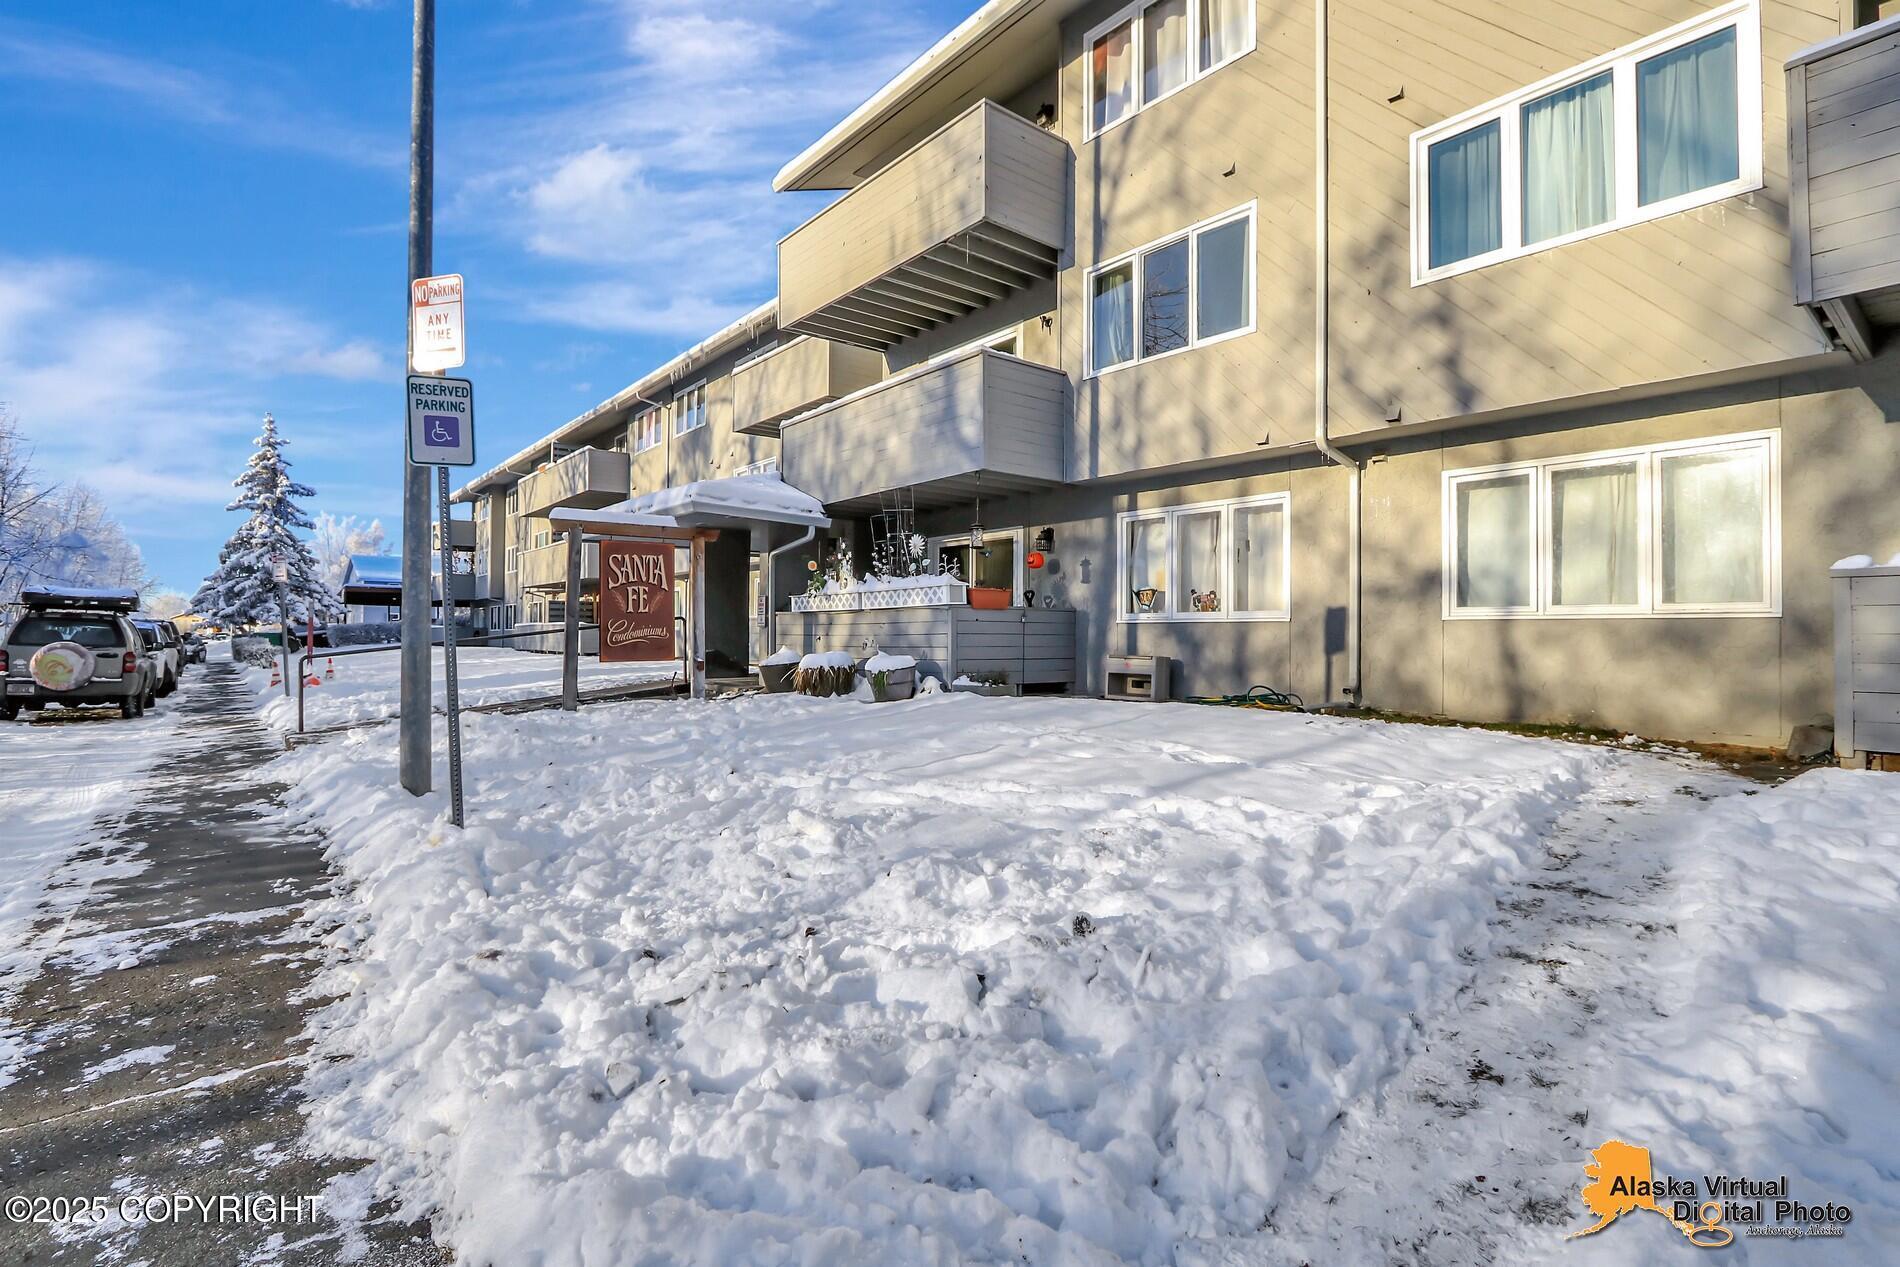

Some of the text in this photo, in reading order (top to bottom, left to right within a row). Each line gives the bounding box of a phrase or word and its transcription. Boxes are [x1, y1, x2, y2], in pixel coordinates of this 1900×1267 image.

[414, 283, 460, 303] NO PARKING
[428, 313, 449, 326] ANY
[427, 328, 452, 341] TIME
[410, 383, 469, 398] RESERVED
[415, 398, 466, 413] PARKING
[608, 553, 669, 591] SANTA
[626, 585, 649, 613] FE
[607, 618, 669, 647] Condominiums
